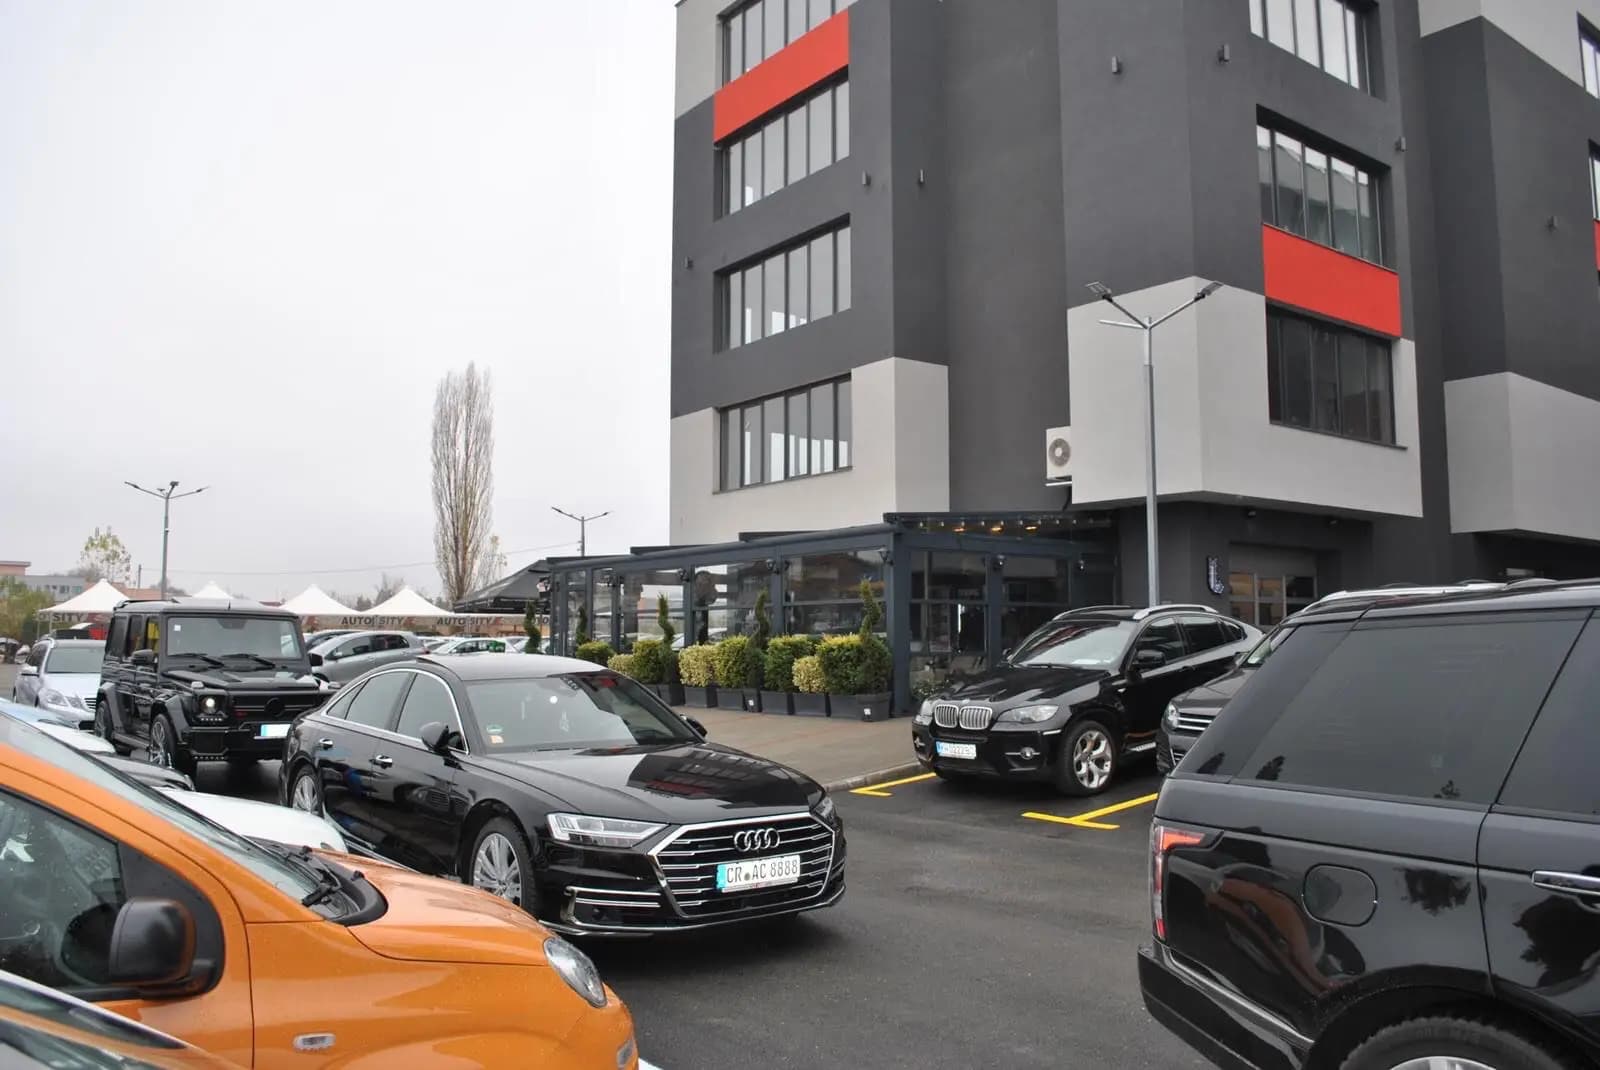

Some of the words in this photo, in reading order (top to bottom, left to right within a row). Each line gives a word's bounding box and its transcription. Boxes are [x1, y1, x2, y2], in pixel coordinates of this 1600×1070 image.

[341, 616, 372, 625] AUTO
[437, 617, 466, 625] AUTO
[726, 866, 742, 884] CR
[752, 863, 767, 881] AC
[770, 859, 798, 878] 8888
